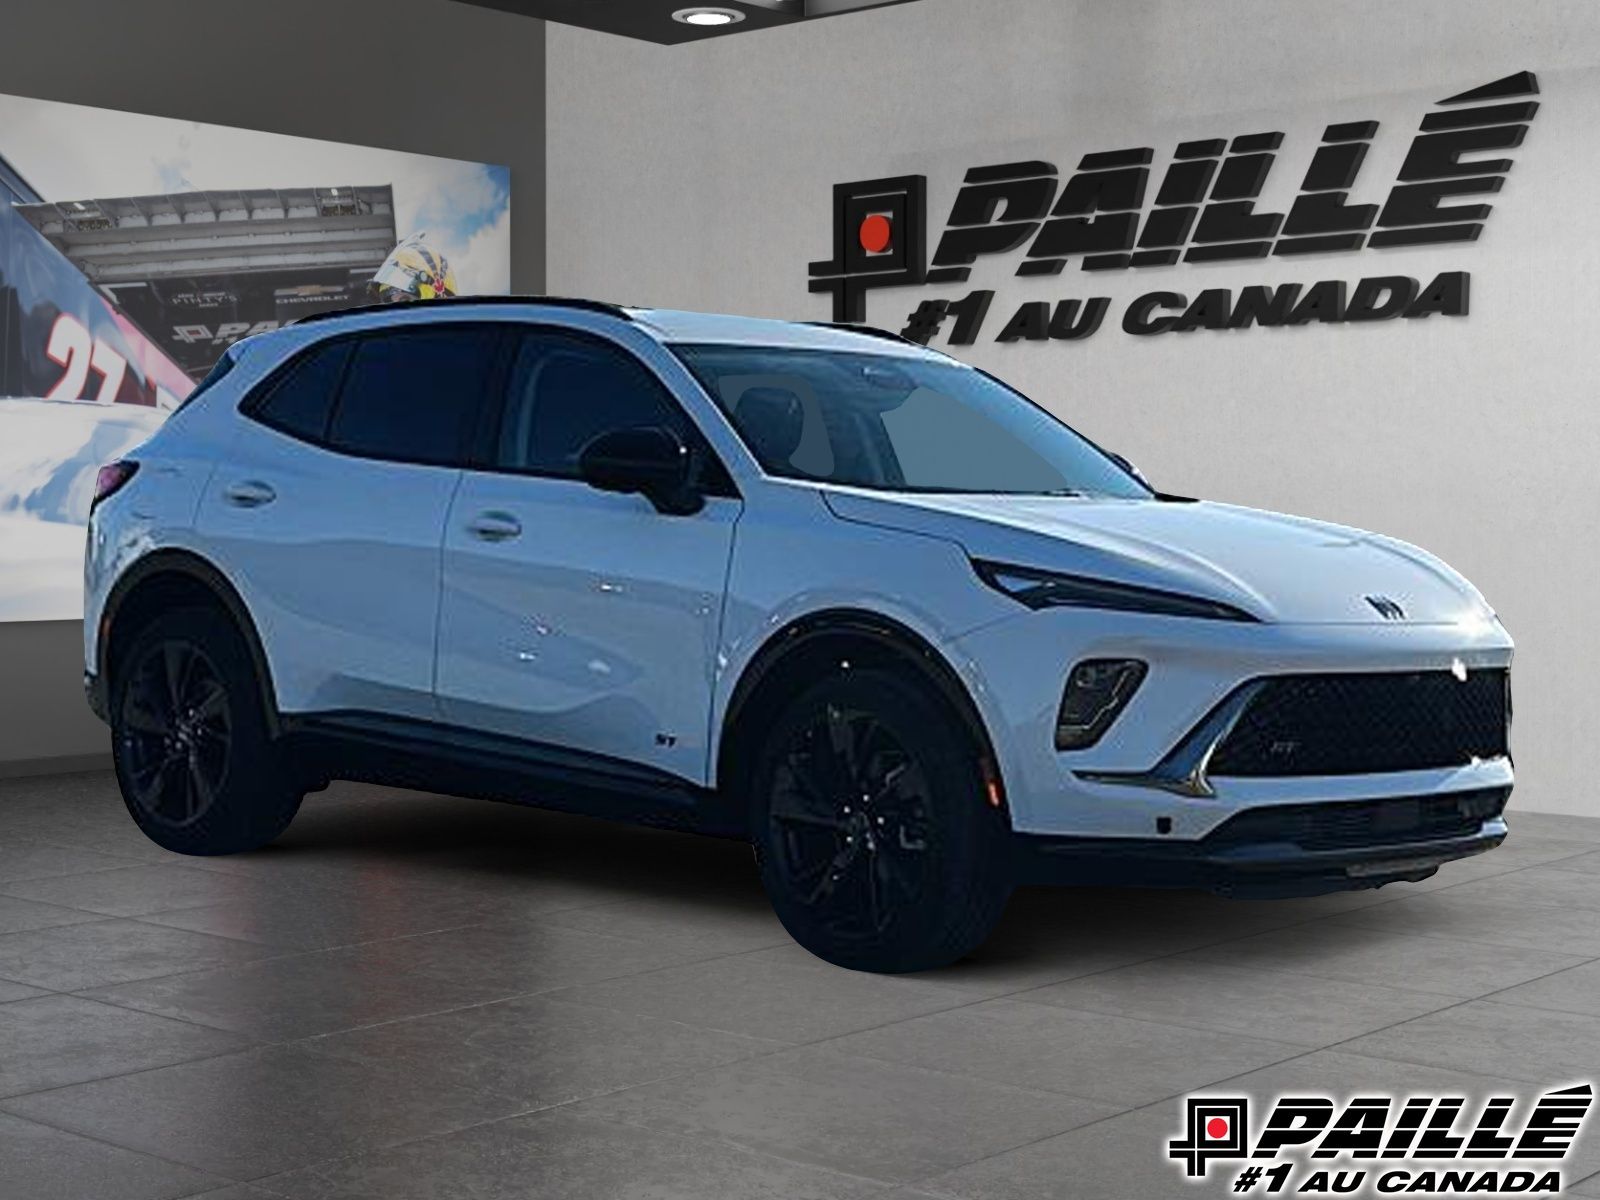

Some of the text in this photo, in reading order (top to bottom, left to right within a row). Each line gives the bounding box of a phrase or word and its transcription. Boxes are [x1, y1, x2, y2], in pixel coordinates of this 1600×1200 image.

[926, 70, 1540, 285] PAILLÉ
[898, 271, 1470, 345] #1 AU CANADA
